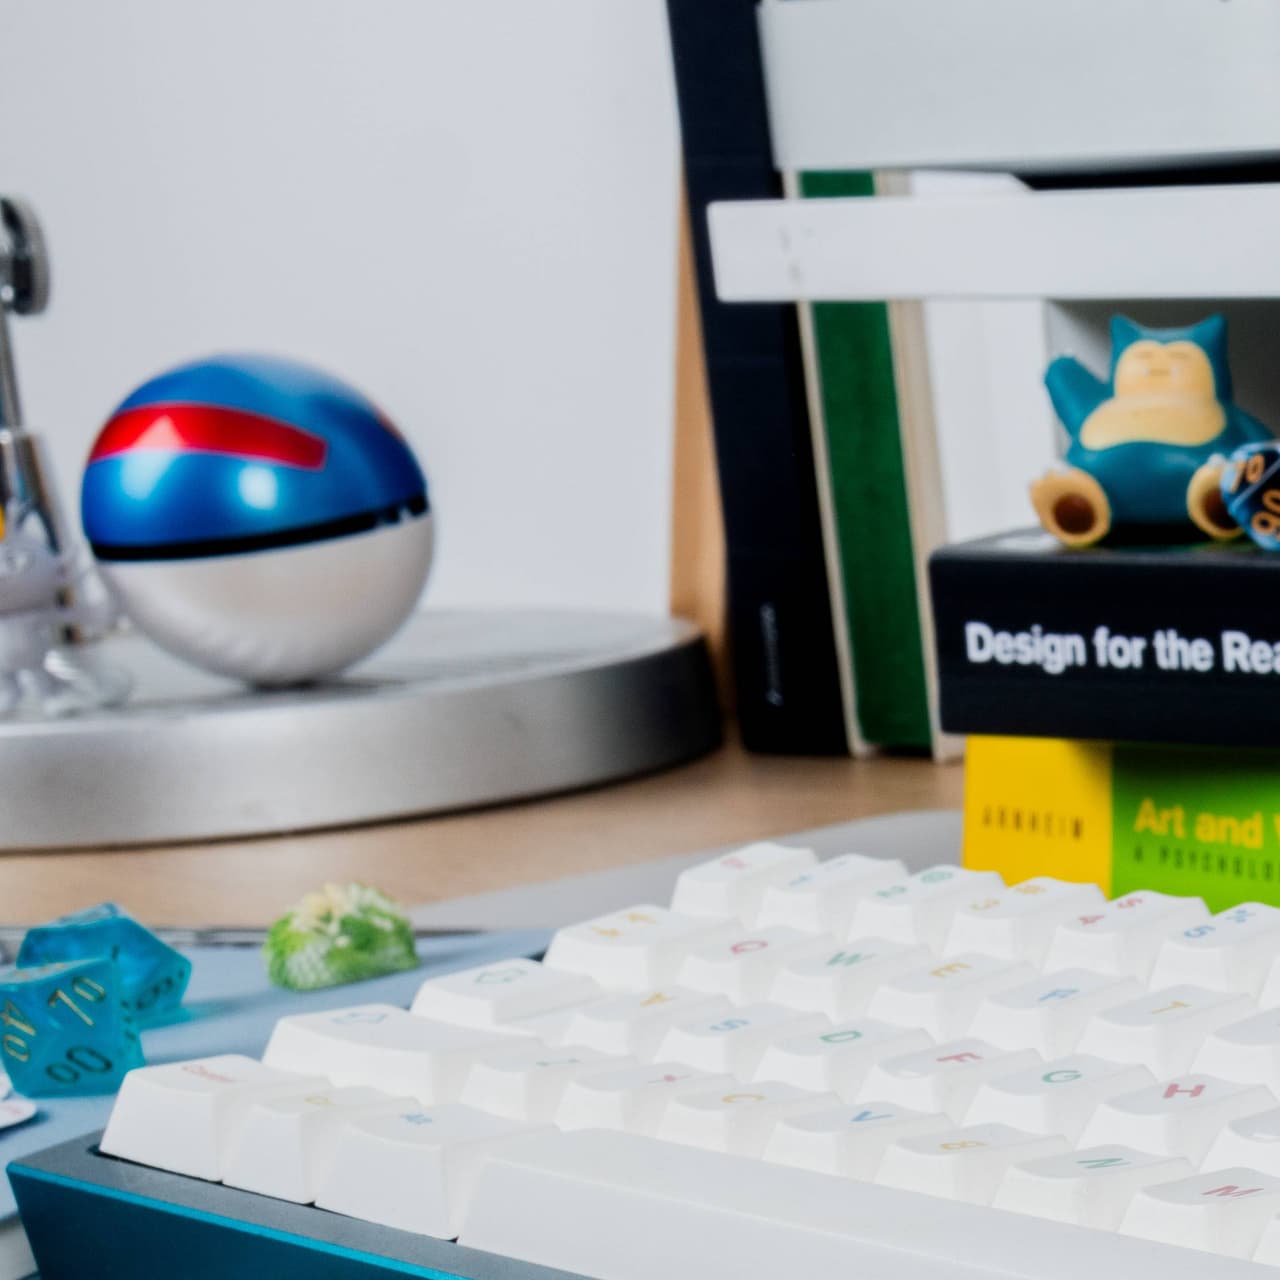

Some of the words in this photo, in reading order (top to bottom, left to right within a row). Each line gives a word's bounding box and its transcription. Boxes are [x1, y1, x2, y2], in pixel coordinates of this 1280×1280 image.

[965, 621, 1087, 674] Design
[1093, 626, 1146, 669] for
[1154, 629, 1214, 671] the
[1133, 798, 1186, 839] Art
[1195, 811, 1264, 849] and
[930, 963, 973, 978] E
[820, 1030, 863, 1043] D
[936, 1052, 985, 1064] F
[1042, 1069, 1083, 1083] G
[1162, 1083, 1206, 1099] H
